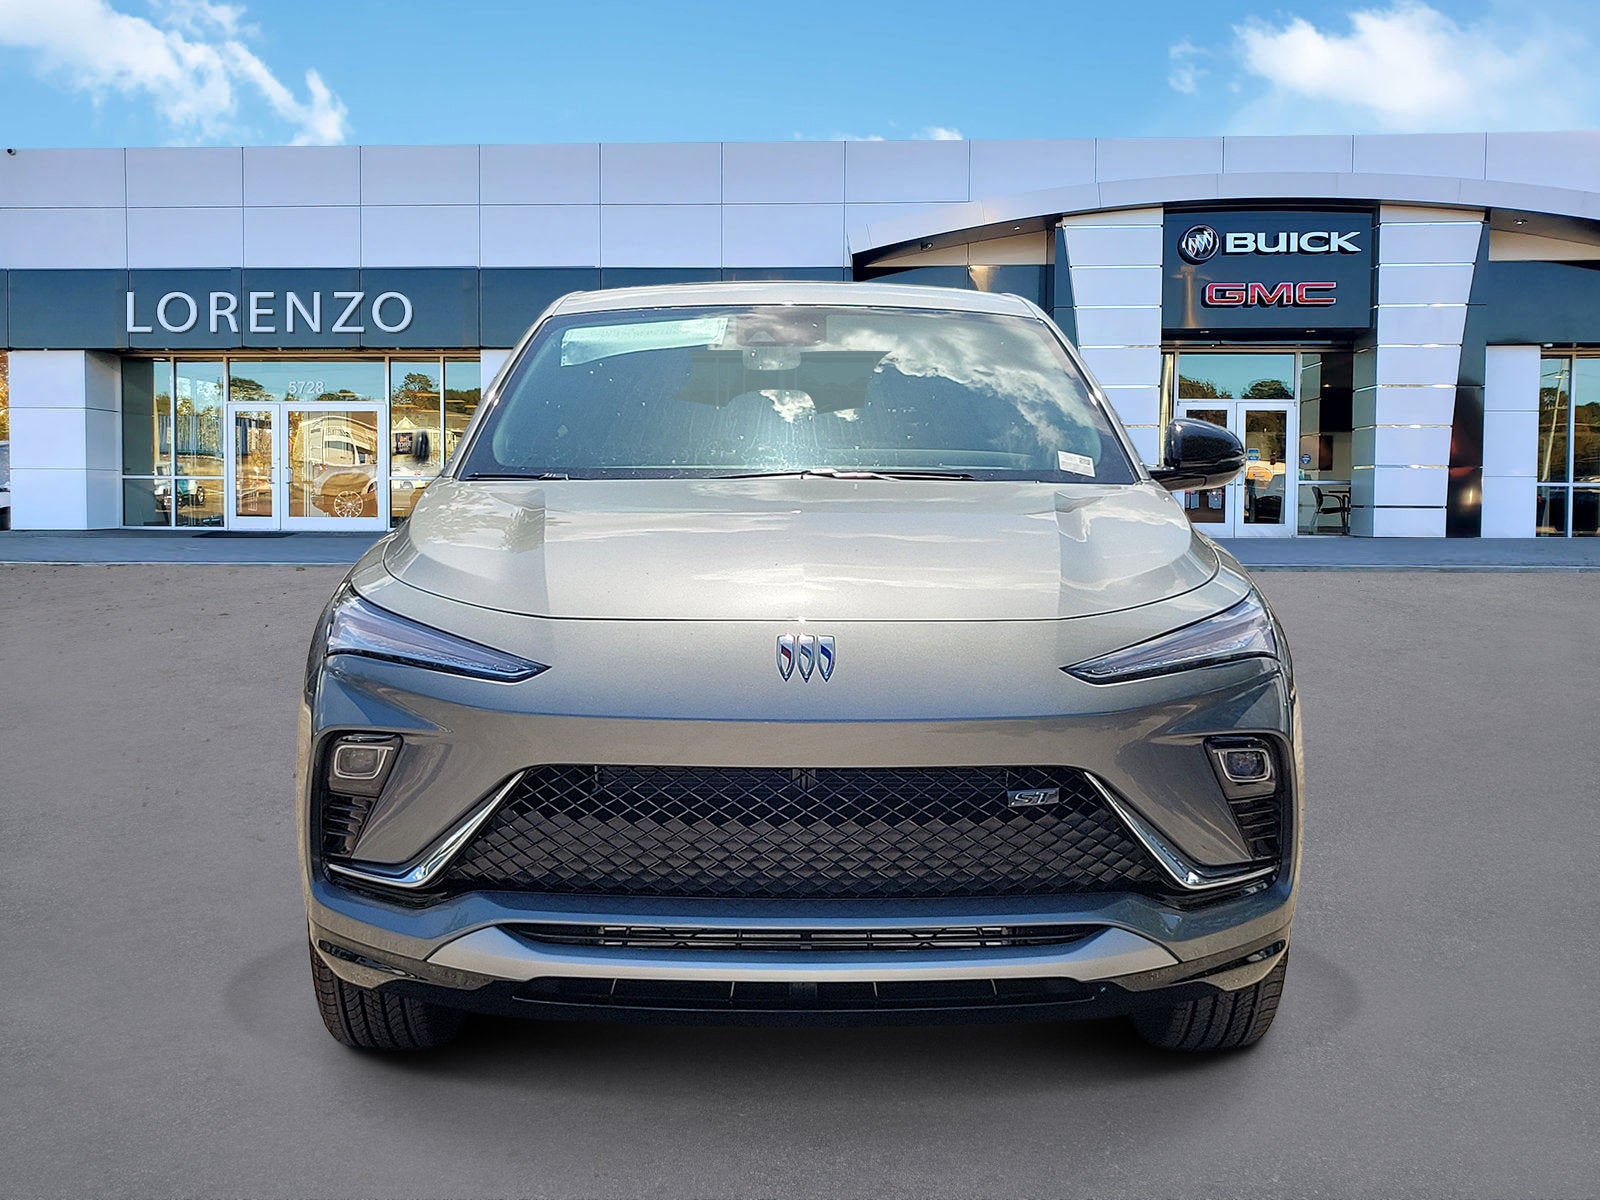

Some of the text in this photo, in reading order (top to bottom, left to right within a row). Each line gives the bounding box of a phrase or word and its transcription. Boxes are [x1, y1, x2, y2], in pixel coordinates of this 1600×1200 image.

[1226, 231, 1362, 253] BUICK
[1206, 281, 1337, 305] GMC
[126, 291, 413, 333] LORENZO
[288, 380, 325, 394] 5728
[1009, 788, 1059, 807] ST
